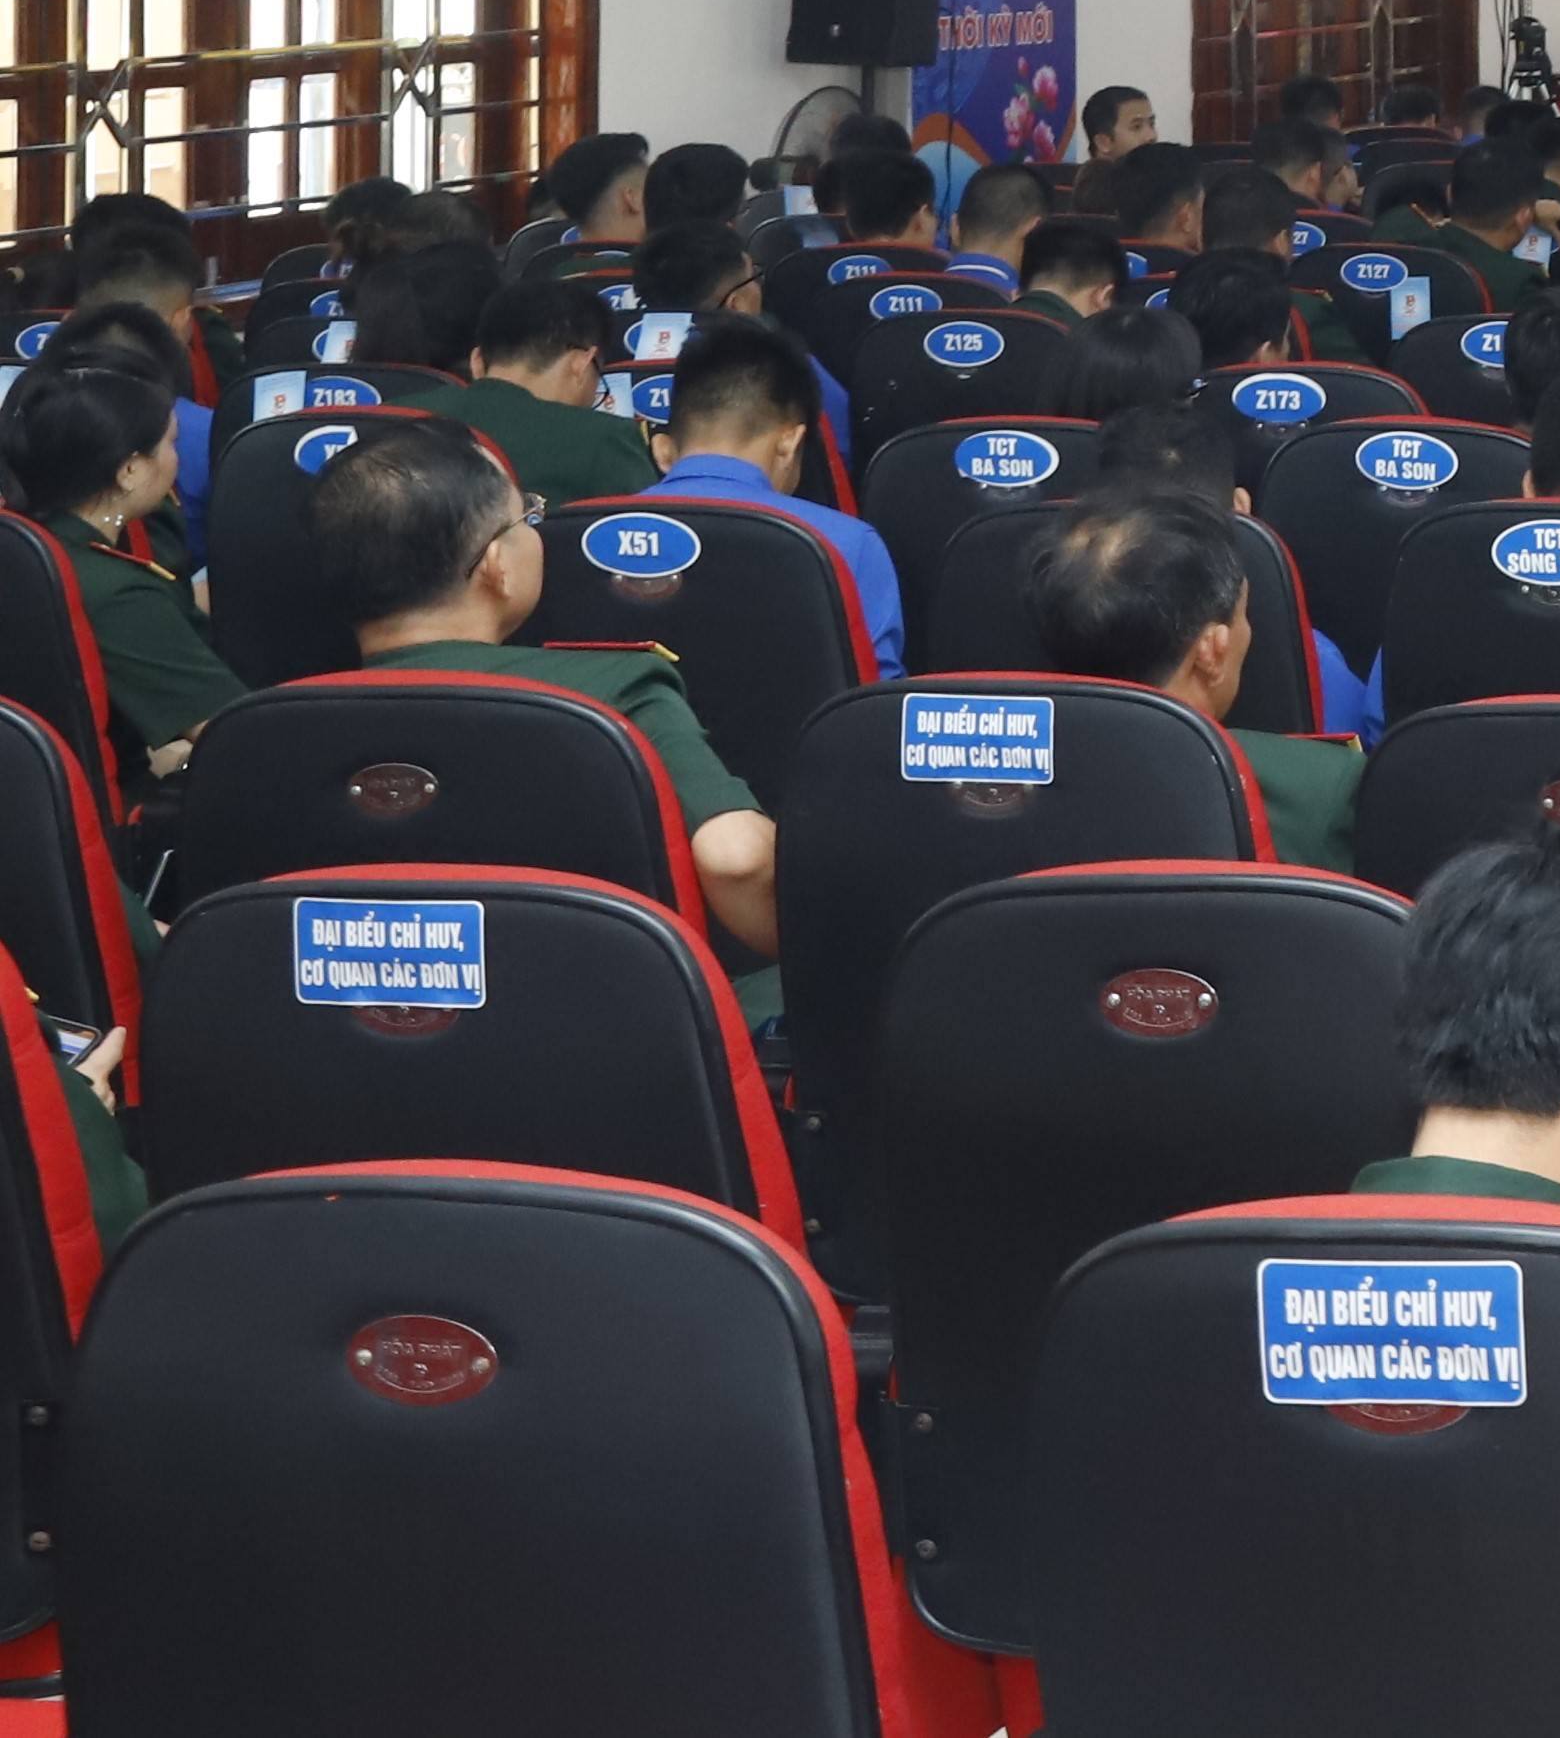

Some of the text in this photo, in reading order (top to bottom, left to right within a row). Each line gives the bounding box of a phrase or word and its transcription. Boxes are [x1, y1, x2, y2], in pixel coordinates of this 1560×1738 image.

[1357, 264, 1390, 280] Z127
[944, 334, 983, 352] Z125
[1256, 390, 1300, 410] Z173
[987, 437, 1016, 457] TCT
[972, 459, 1033, 477] BA SON
[617, 529, 660, 557] X51
[1507, 549, 1556, 575] SÔNG
[1284, 1276, 1497, 1332] ĐẠI BIỂU CHỈ HUY,
[1270, 1338, 1520, 1390] CƠ QUAN CÁC ĐƠN VỊ
